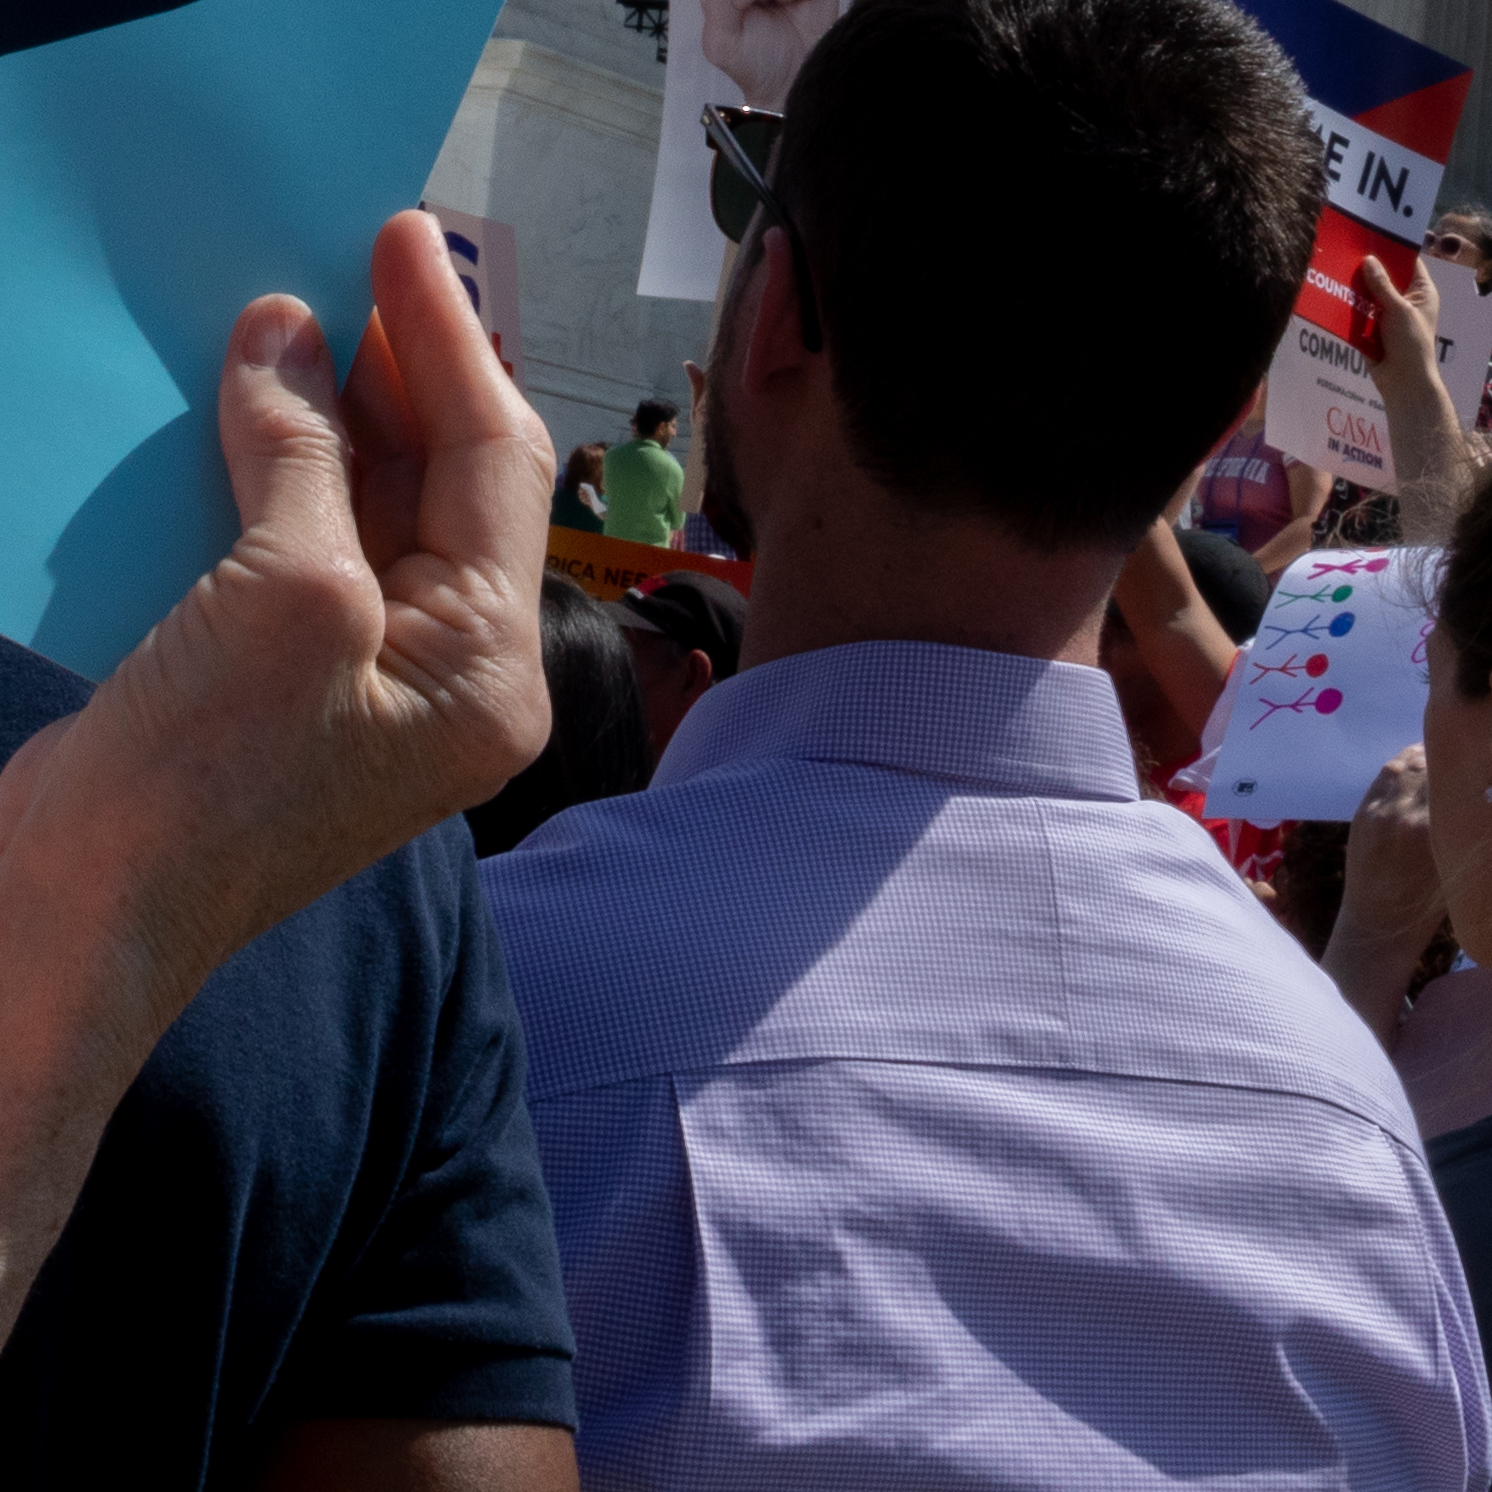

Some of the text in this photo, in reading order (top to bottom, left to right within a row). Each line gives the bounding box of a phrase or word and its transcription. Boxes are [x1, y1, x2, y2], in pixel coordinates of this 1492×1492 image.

[1357, 150, 1414, 219] IN.
[1299, 327, 1369, 379] COMMU
[1326, 406, 1382, 453] CASA
